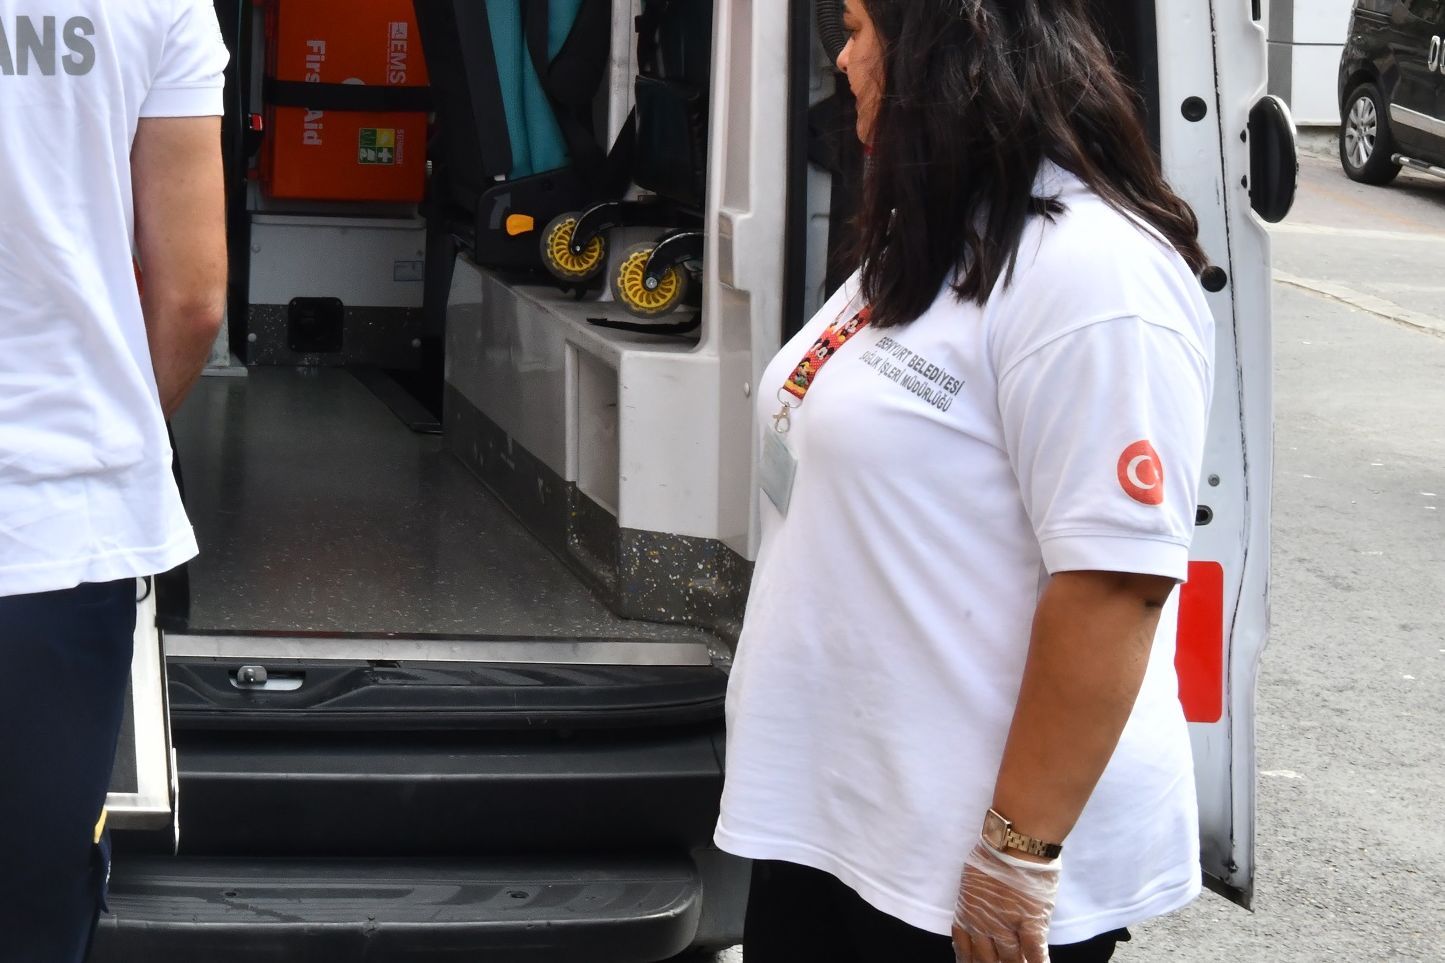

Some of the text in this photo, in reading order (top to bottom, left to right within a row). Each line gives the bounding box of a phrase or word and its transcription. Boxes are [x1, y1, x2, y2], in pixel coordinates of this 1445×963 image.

[389, 39, 408, 84] EMS
[303, 40, 326, 146] Firs Aid
[875, 336, 966, 396] ESENYURT BELEDİYESİ
[900, 374, 954, 412] MÜDÜRLÜĞÜ
